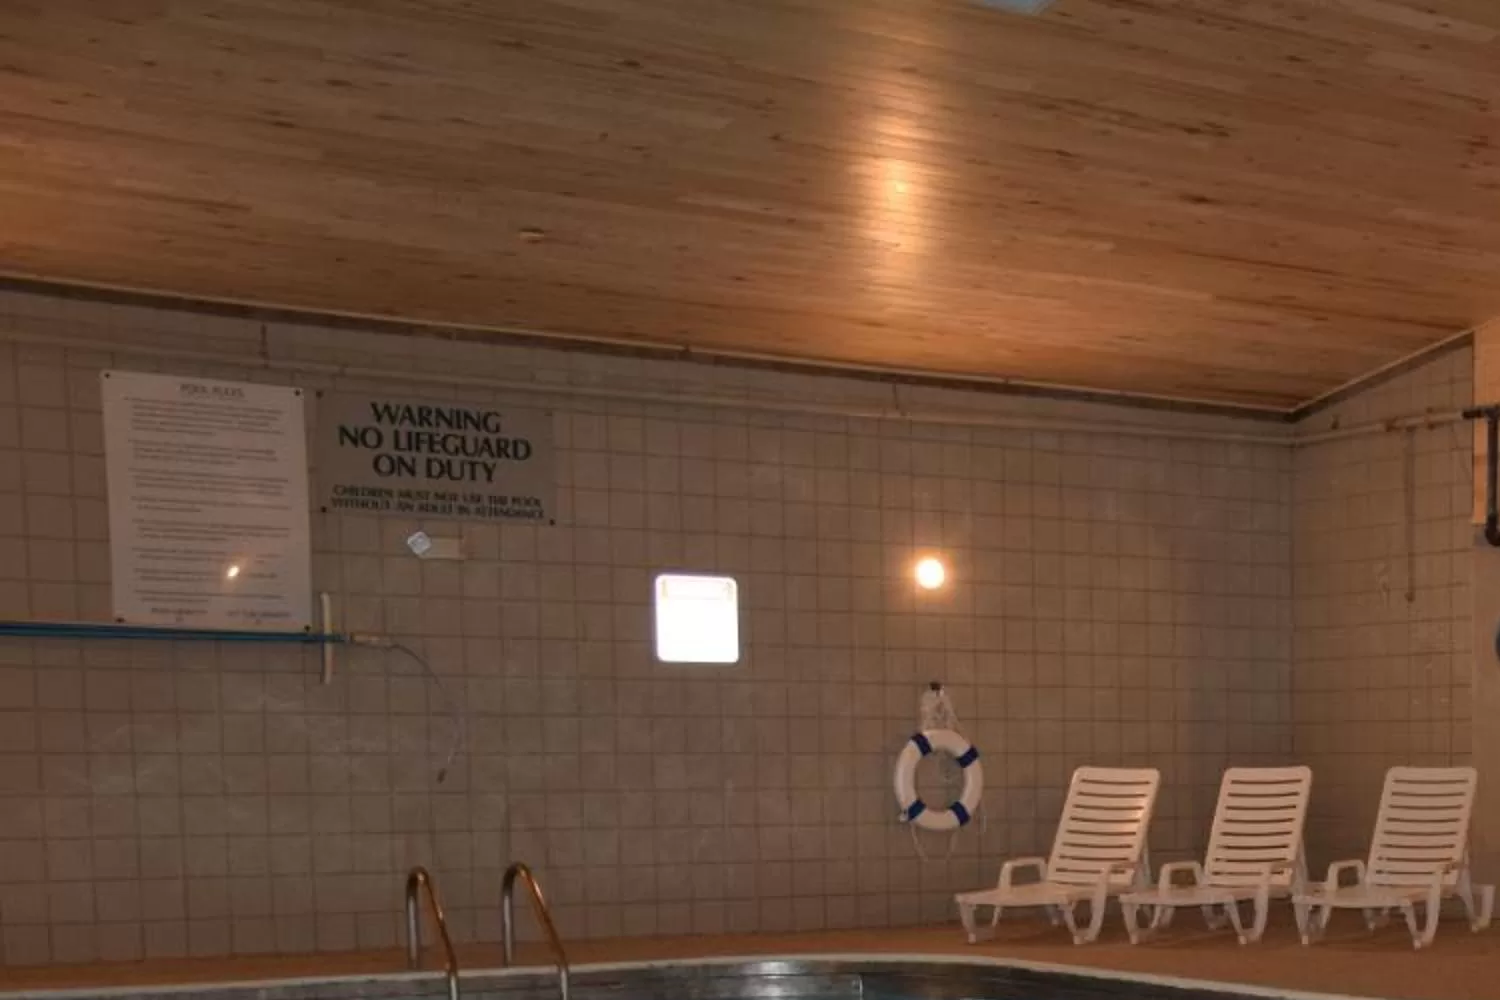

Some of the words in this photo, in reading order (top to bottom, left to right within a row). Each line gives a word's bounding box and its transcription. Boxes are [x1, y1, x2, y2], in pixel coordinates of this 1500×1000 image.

[371, 402, 501, 434] WARNING
[338, 424, 384, 450] NO
[393, 429, 533, 461] LIFEGUARD
[372, 453, 417, 478] ON
[425, 457, 497, 483] DUTY
[330, 496, 390, 511] WITHOUT
[332, 484, 394, 499] CHILDREN
